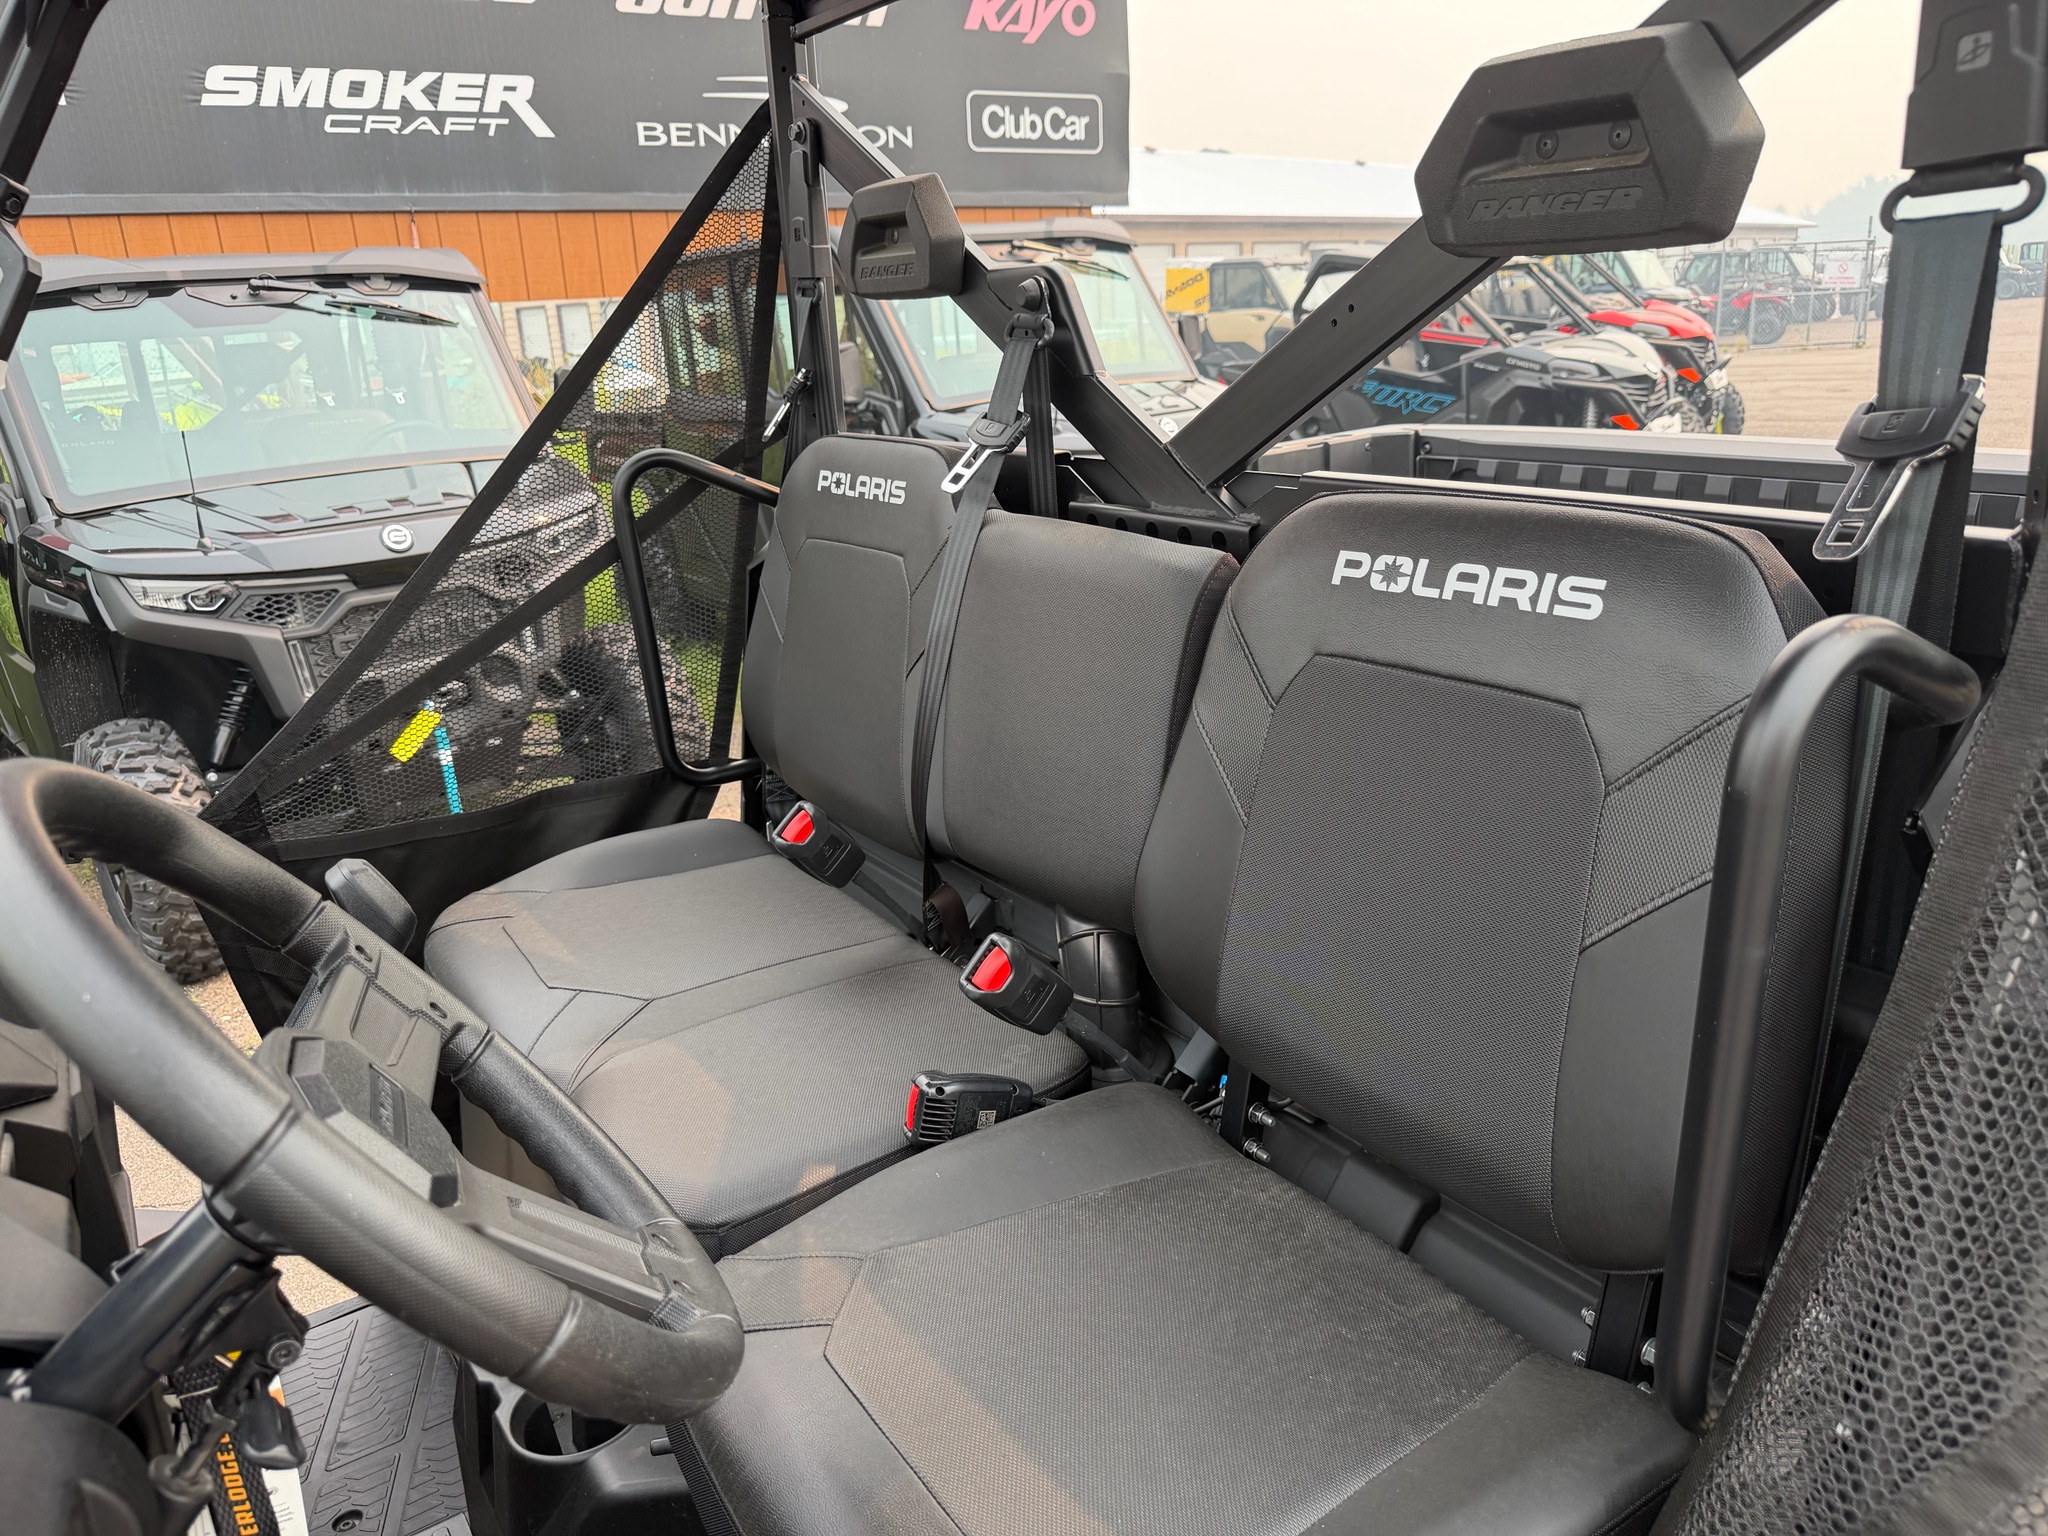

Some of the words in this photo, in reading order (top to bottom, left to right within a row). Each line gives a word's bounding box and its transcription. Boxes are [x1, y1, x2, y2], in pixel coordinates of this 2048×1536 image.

[963, 0, 1097, 44] KAYO
[200, 65, 556, 138] SMOKER
[323, 114, 510, 136] CRAFT
[636, 122, 913, 149] BENON
[981, 104, 1043, 140] Club
[1044, 106, 1089, 141] Car
[1467, 185, 1643, 221] RANGER
[860, 263, 915, 280] RANGER
[817, 469, 907, 505] POLARIS
[1331, 550, 1607, 621] POLARIS
